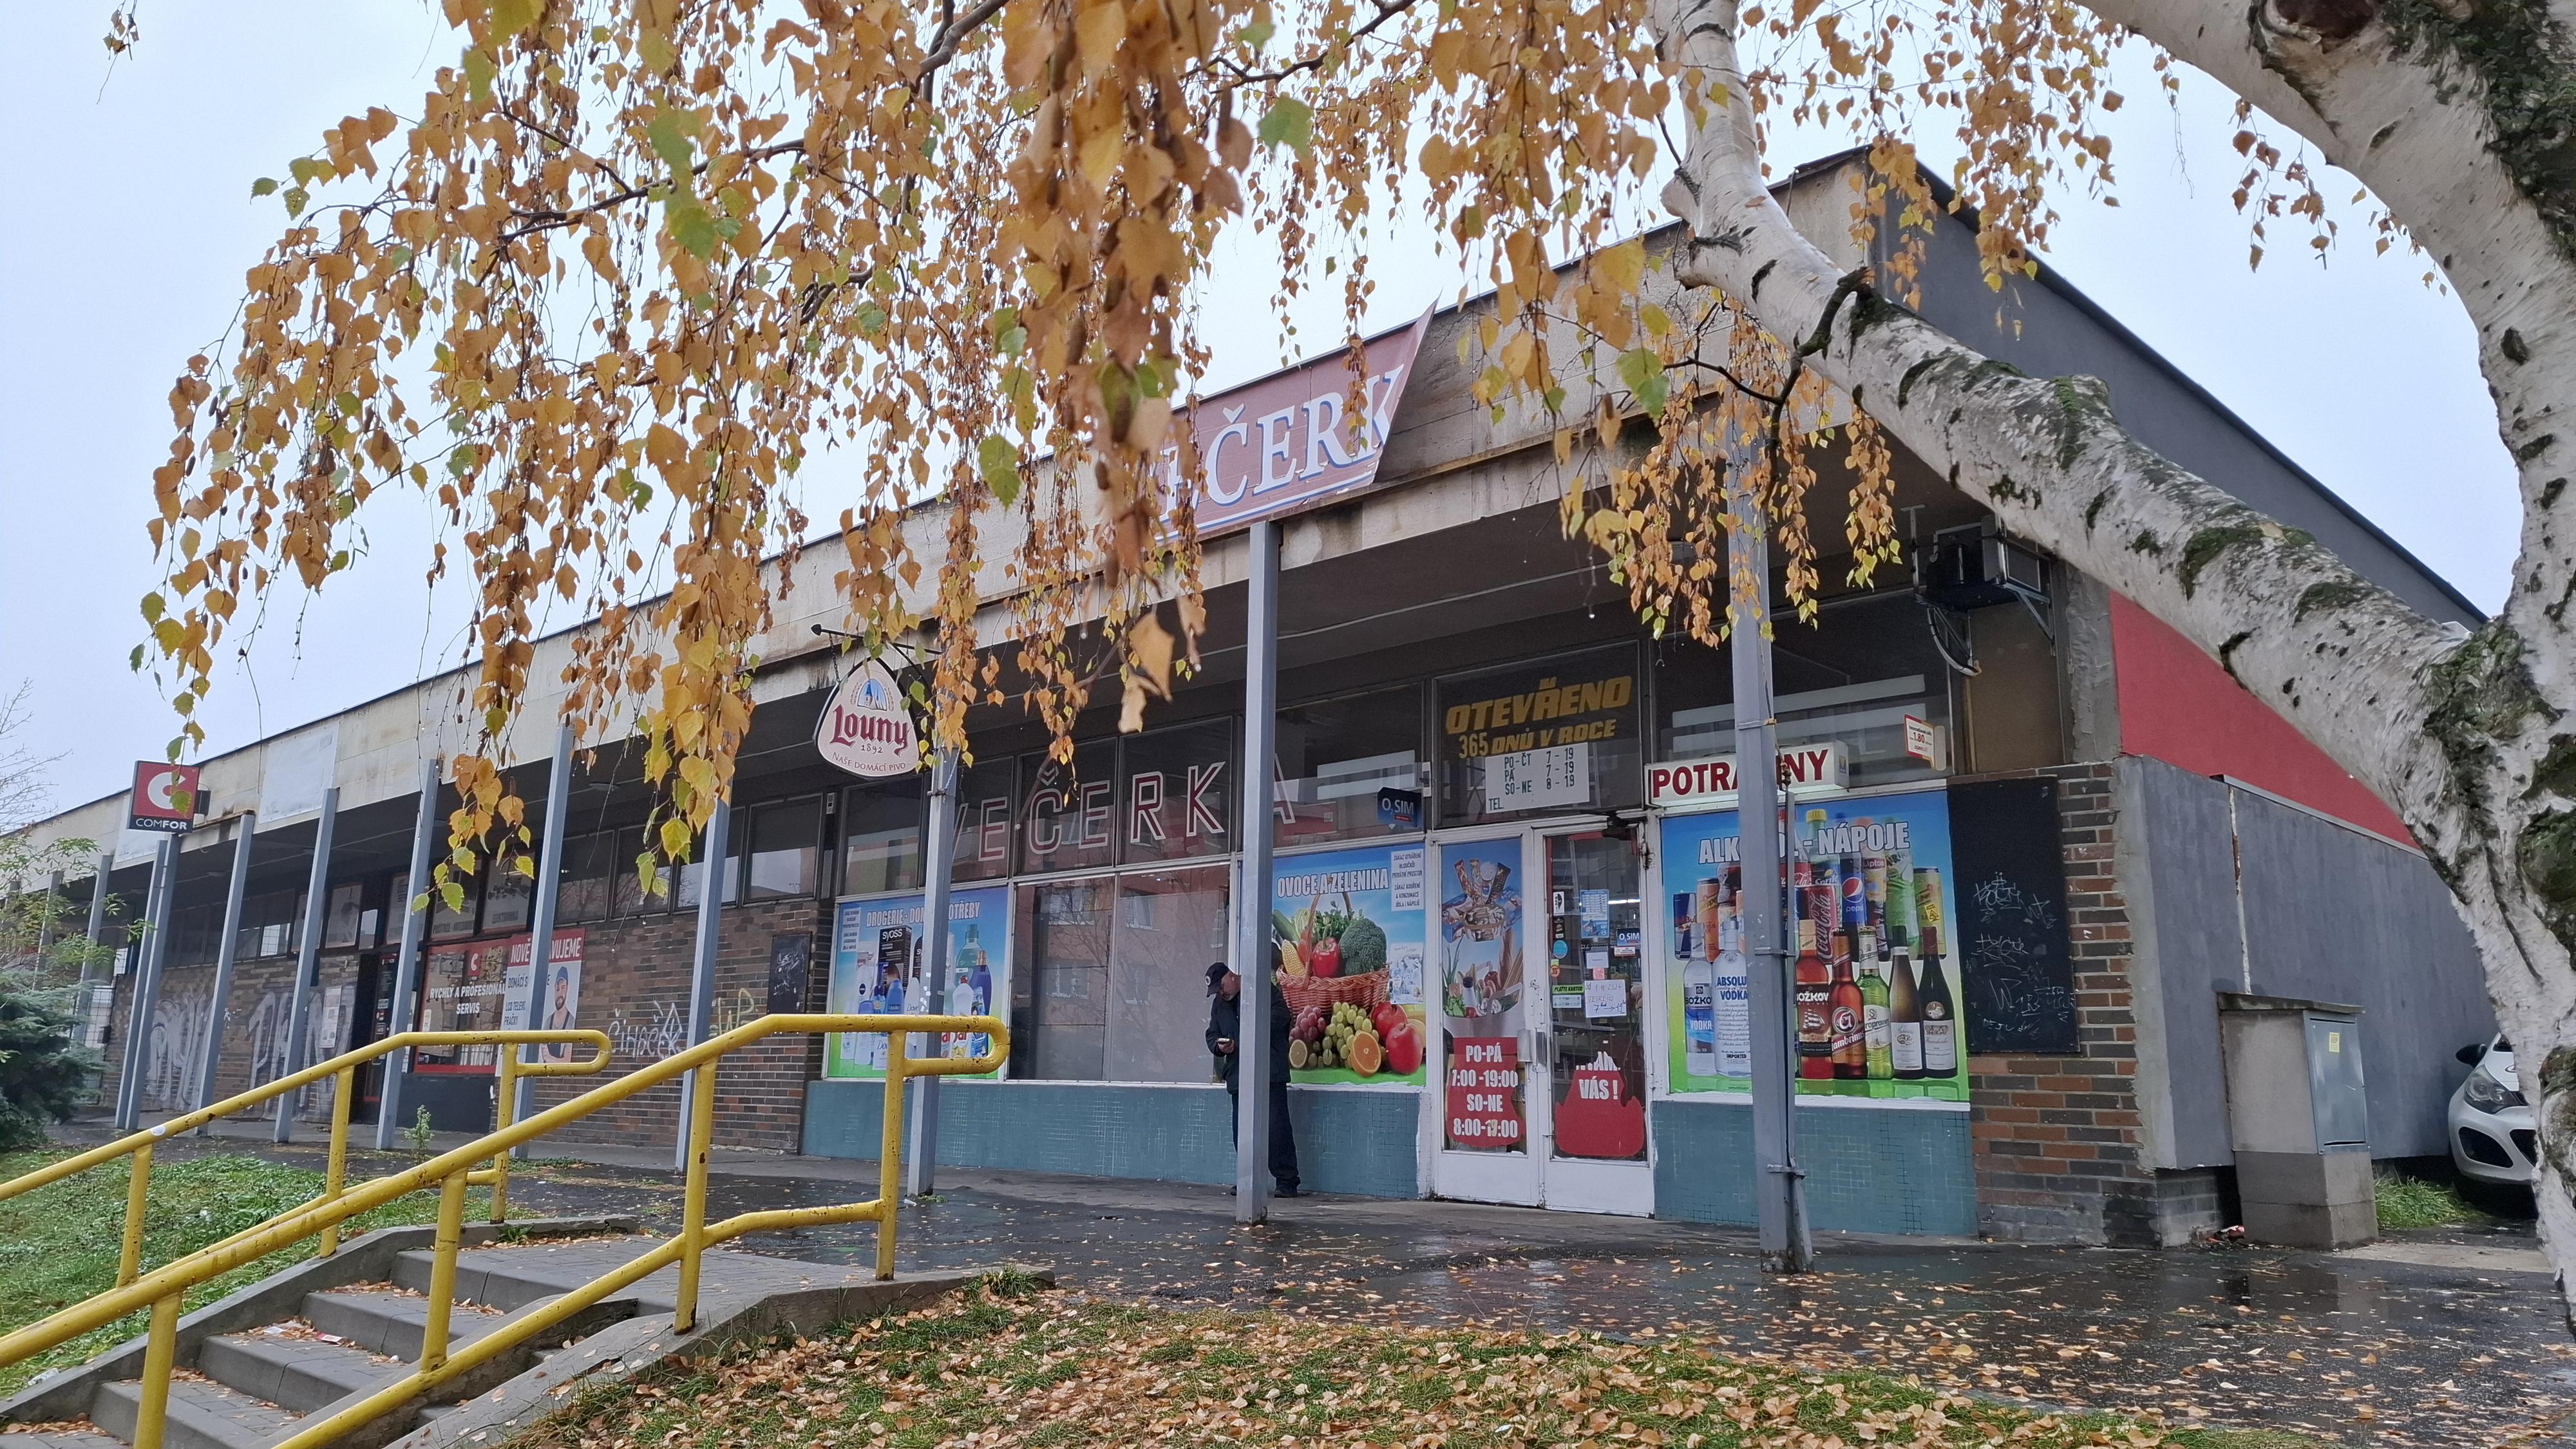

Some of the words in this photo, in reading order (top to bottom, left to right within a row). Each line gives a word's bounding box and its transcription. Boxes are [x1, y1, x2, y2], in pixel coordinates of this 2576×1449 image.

[1445, 676, 1633, 734] OTEVŘENO
[829, 704, 908, 756] Louny
[1459, 732, 1489, 759] 365
[1491, 727, 1534, 755] DNŮ
[1539, 728, 1555, 748] V
[1557, 719, 1617, 744] ROCE
[860, 743, 884, 753] 1892
[854, 761, 887, 772] DOMÁCÍ
[889, 762, 906, 771] PIVO
[1504, 752, 1531, 769] PO-ČT
[1546, 750, 1551, 764] 7
[1565, 747, 1574, 761] 19
[1504, 768, 1515, 782] PÁ
[1546, 764, 1551, 777] 7
[1565, 761, 1575, 774] 19
[1653, 748, 1829, 799] POTRINY
[1505, 780, 1532, 795] SO-NE
[1546, 777, 1552, 790] 8
[1565, 774, 1575, 788] 19
[1394, 799, 1414, 815] SIM
[135, 818, 187, 831] COMFOR
[1817, 821, 1910, 855] NÁPOJE
[1277, 873, 1318, 898] OVOCE
[1318, 873, 1331, 894] A
[1330, 867, 1390, 894] ZELENINA
[866, 908, 904, 927] DROGERIE
[948, 899, 980, 920] OTŘEBY
[882, 928, 902, 942] syoss
[1627, 932, 1640, 941] SIM
[511, 938, 531, 963] NOVĚ
[1717, 976, 1747, 987] ABSOLU
[430, 985, 454, 999] RYCHLÝ
[455, 987, 460, 997] A
[1685, 996, 1712, 1005] OŽKO
[1720, 990, 1748, 1000] VODKA
[456, 1002, 480, 1015] SERVIS
[1690, 1019, 1712, 1030] VODKA
[1466, 1042, 1502, 1063] PO-PÁ
[1452, 1070, 1476, 1087] 7:00
[1578, 1075, 1609, 1100] VÁS
[1466, 1094, 1503, 1112] SO-NE
